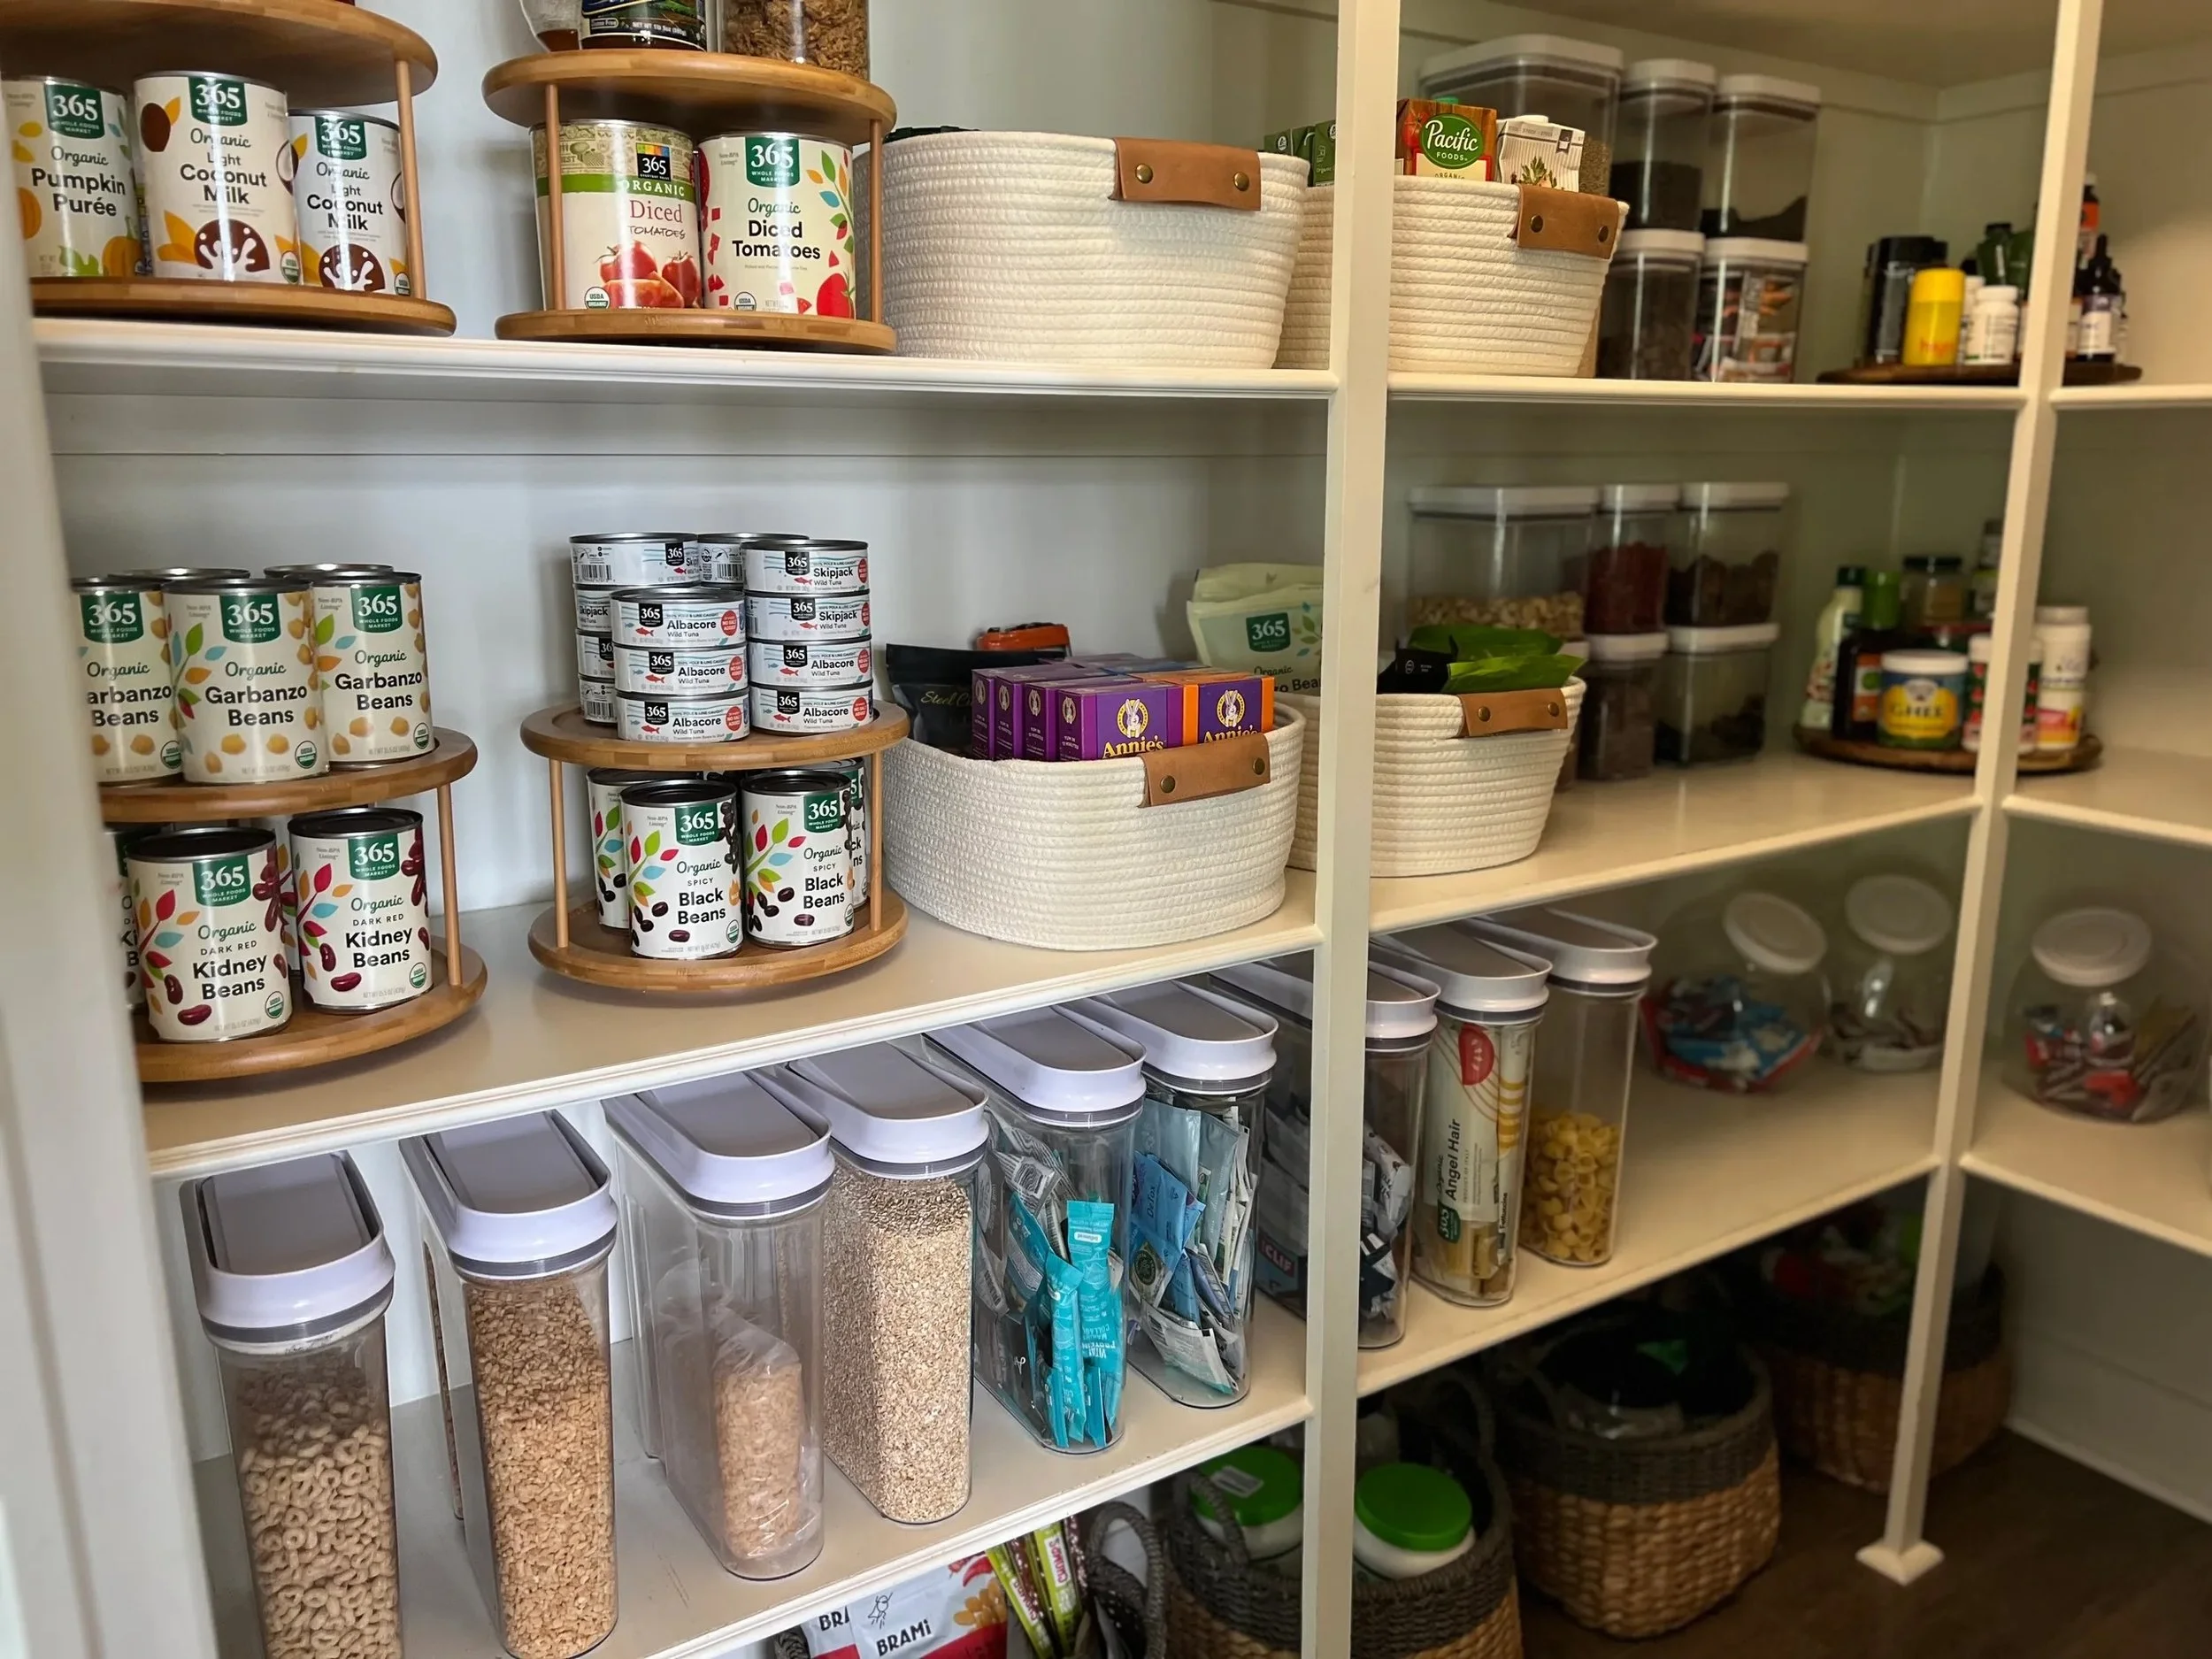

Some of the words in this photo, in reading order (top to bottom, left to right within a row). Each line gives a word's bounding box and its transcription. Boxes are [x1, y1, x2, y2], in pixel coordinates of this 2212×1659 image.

[196, 83, 241, 109] 365
[52, 94, 98, 120] 365
[190, 128, 251, 149] Oranic
[321, 121, 361, 145] 365
[1425, 119, 1479, 152] Pacific
[50, 146, 109, 166] Organic
[207, 152, 242, 166] Lght
[751, 142, 794, 169] 365
[1436, 151, 1463, 161] FOODS
[316, 162, 371, 180] Oranic
[642, 157, 666, 174] 365
[31, 167, 126, 196] Pumpkin
[620, 179, 685, 196] ORGANIC
[331, 186, 361, 197] Lght
[53, 193, 117, 217] Purée
[630, 199, 683, 223] Diced
[748, 197, 801, 218] Organic
[628, 226, 686, 240] TOMATOES
[749, 220, 803, 238] Diced
[732, 240, 820, 259] Tomatoes
[667, 548, 683, 559] 365
[787, 556, 807, 568] 365
[814, 567, 853, 579] Skipjack
[88, 601, 136, 626] 365
[227, 601, 274, 626] 365
[357, 594, 397, 617] 365
[641, 607, 661, 619] 365
[793, 602, 813, 613] 365
[666, 620, 717, 630] Albacore
[819, 611, 857, 623] Skipjack
[1251, 619, 1286, 641] 365
[601, 643, 613, 654] 36
[785, 649, 805, 660] 365
[355, 649, 407, 668] Organic
[651, 655, 672, 667] 365
[810, 660, 855, 670] Albacore
[87, 662, 150, 680] Organic
[225, 662, 287, 681] Organic
[678, 667, 726, 677] Albacore
[334, 672, 422, 690] Garbanzo
[1292, 679, 1321, 691] Bea
[87, 686, 172, 704] arbanzo
[205, 686, 308, 704] Garbanzo
[357, 694, 413, 710] Beans
[779, 695, 798, 707] 365
[920, 691, 956, 706] Steel
[92, 709, 159, 727] Beans
[227, 709, 294, 726] Beans
[647, 706, 666, 718] 365
[803, 708, 849, 718] Albacore
[672, 718, 722, 727] Albacore
[1102, 735, 1164, 759] Annie's
[808, 800, 838, 820] 365
[680, 811, 714, 833] 365
[354, 842, 394, 866] 365
[803, 846, 842, 863] Organic
[677, 860, 722, 877] Organic
[813, 863, 836, 872] SPICY
[200, 865, 245, 891] 365
[687, 878, 714, 887] SPICY
[805, 872, 844, 892] Black
[350, 895, 404, 914] Organic
[679, 888, 724, 907] Black
[803, 891, 845, 910] Beans
[352, 918, 382, 926] DARK
[386, 913, 404, 923] RED
[678, 908, 726, 925] Beans
[198, 920, 257, 941] Organic
[346, 927, 413, 949] Kidney
[200, 945, 233, 956] DARK
[237, 940, 257, 950] RED
[193, 955, 267, 979] Kidney
[353, 949, 411, 968] Beans
[202, 978, 265, 1000] Beans
[1448, 1118, 1461, 1153] Hair
[1445, 1154, 1461, 1202] Angel
[1265, 1243, 1293, 1272] CLIF
[818, 1606, 850, 1632] BRA
